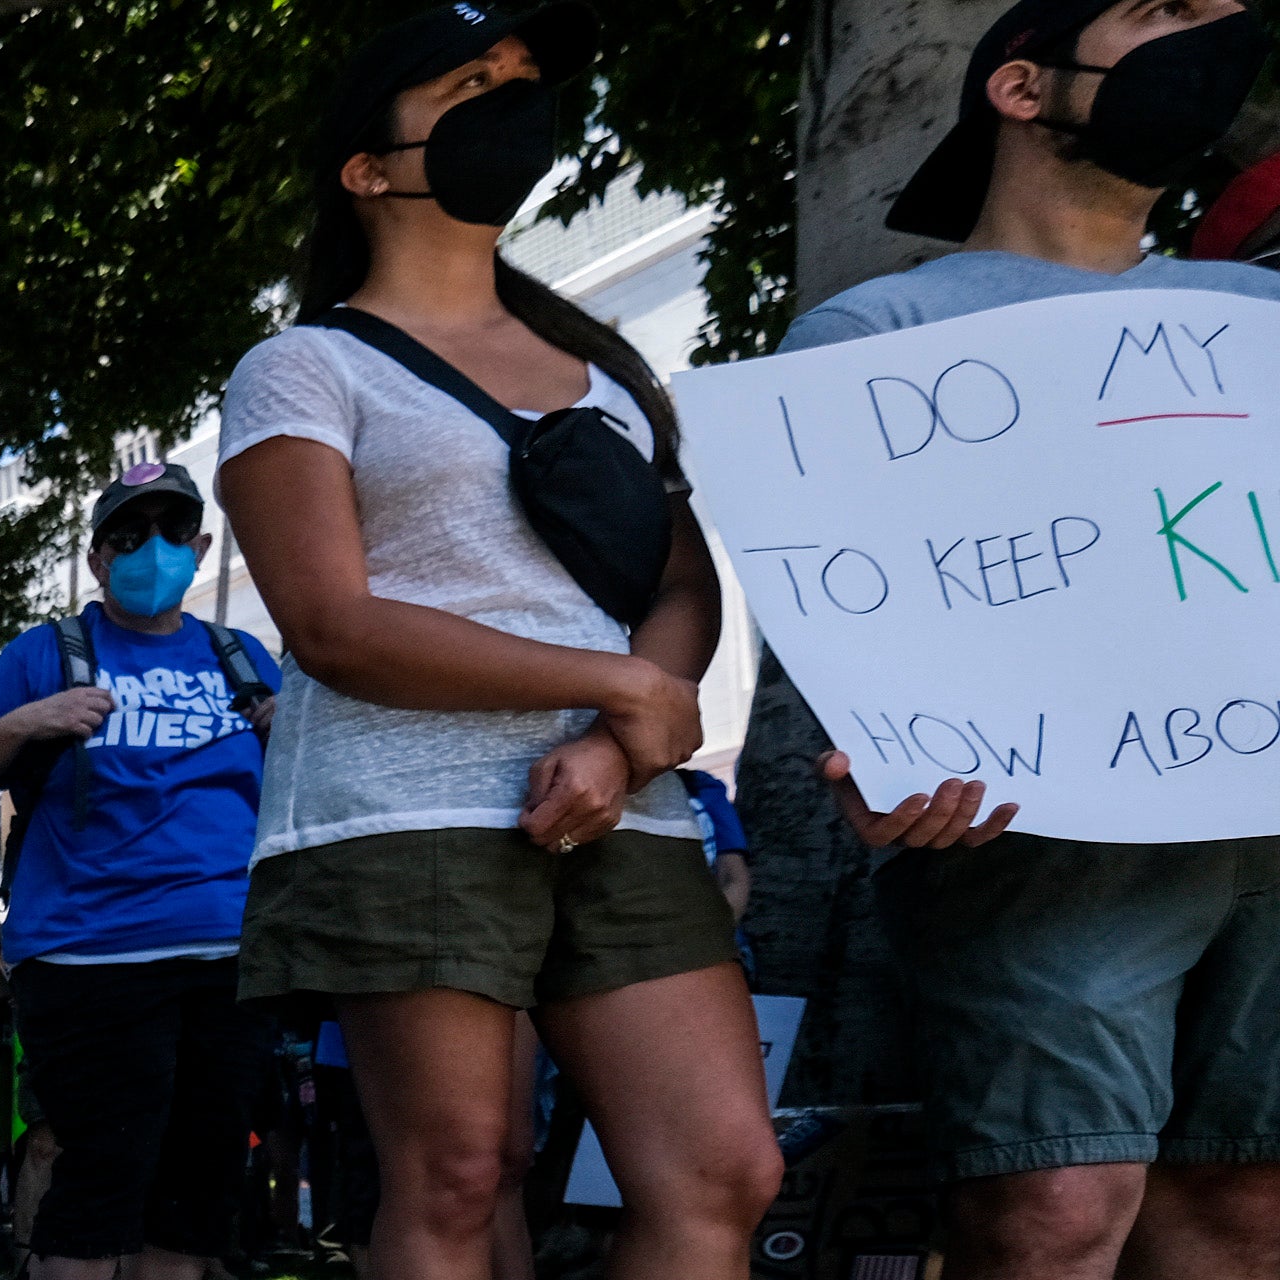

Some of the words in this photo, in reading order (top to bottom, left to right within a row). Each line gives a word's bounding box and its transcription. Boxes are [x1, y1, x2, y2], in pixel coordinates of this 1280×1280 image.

[778, 395, 805, 477] I
[866, 359, 1020, 461] DO
[1097, 322, 1230, 401] MY
[742, 545, 889, 616] TO
[926, 516, 1100, 610] KEEP
[851, 709, 1045, 777] HOW
[1109, 699, 1280, 776] ABO
